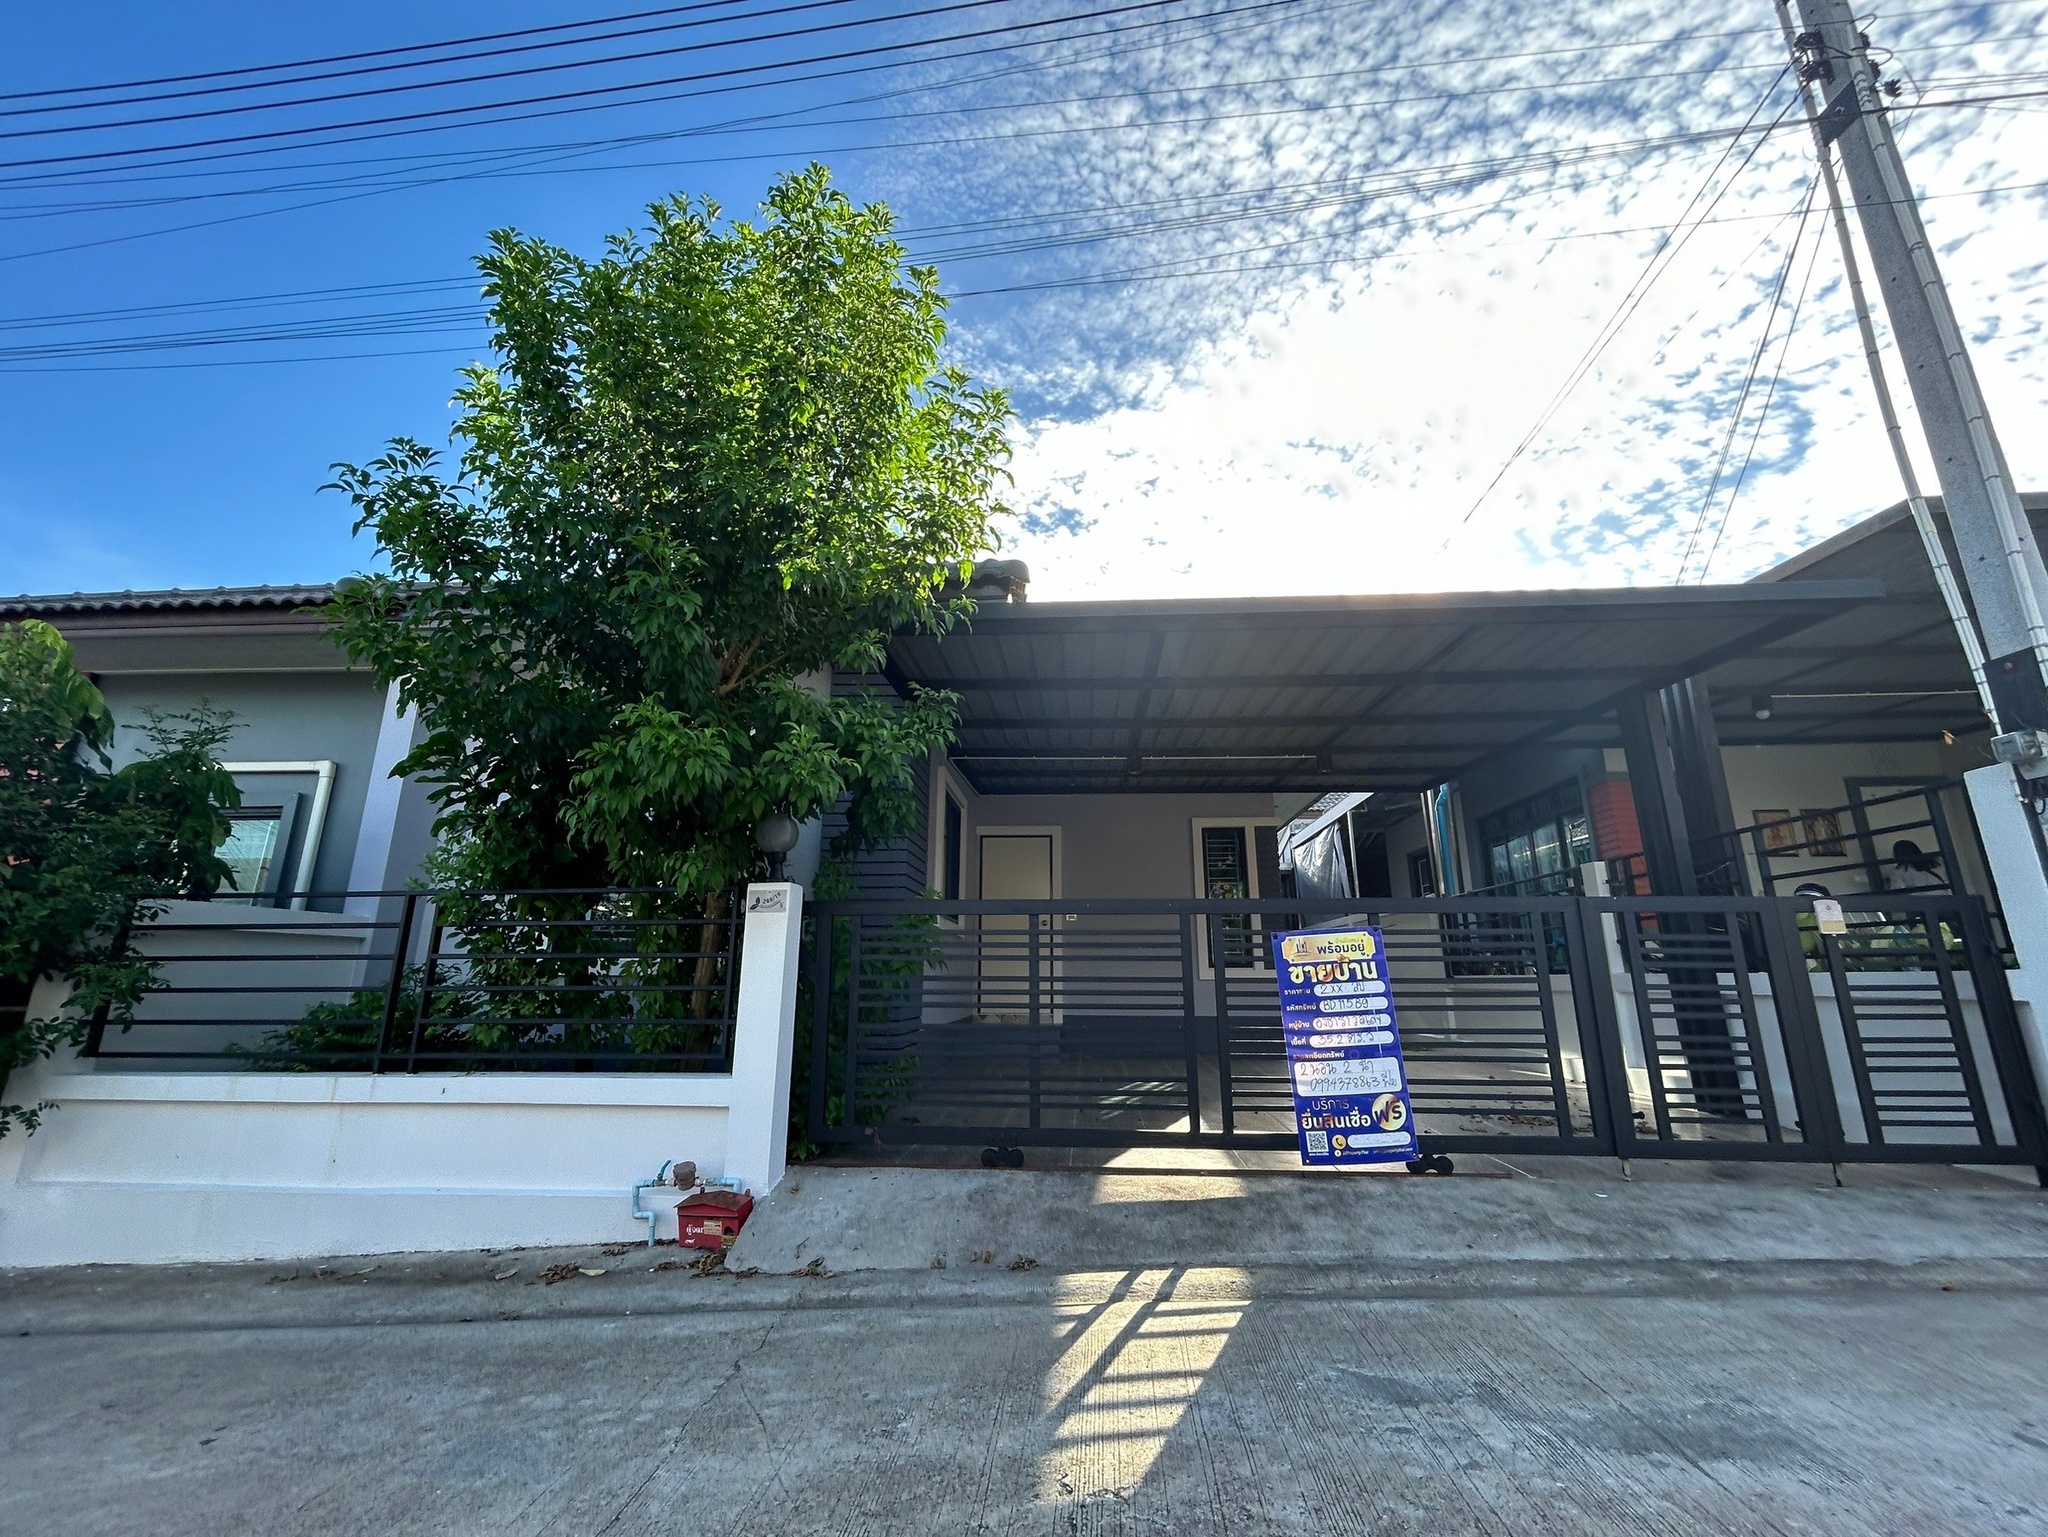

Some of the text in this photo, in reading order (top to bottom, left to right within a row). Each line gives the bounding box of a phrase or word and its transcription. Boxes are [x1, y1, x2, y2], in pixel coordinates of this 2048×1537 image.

[1317, 939, 1366, 956] พร้อมอยู่
[1287, 954, 1379, 984] ขายบ้าน
[1286, 1003, 1317, 1012] รหัสทรัพย์
[1288, 1020, 1310, 1030] หมู่บ้าน
[1293, 1049, 1345, 1060] รายละเอียดทรัพย์
[1300, 1062, 1308, 1076] 2
[1343, 1060, 1352, 1074] 2
[1311, 1097, 1350, 1110] บริการ
[1301, 1107, 1371, 1130] ยื่นสินเชื่อ
